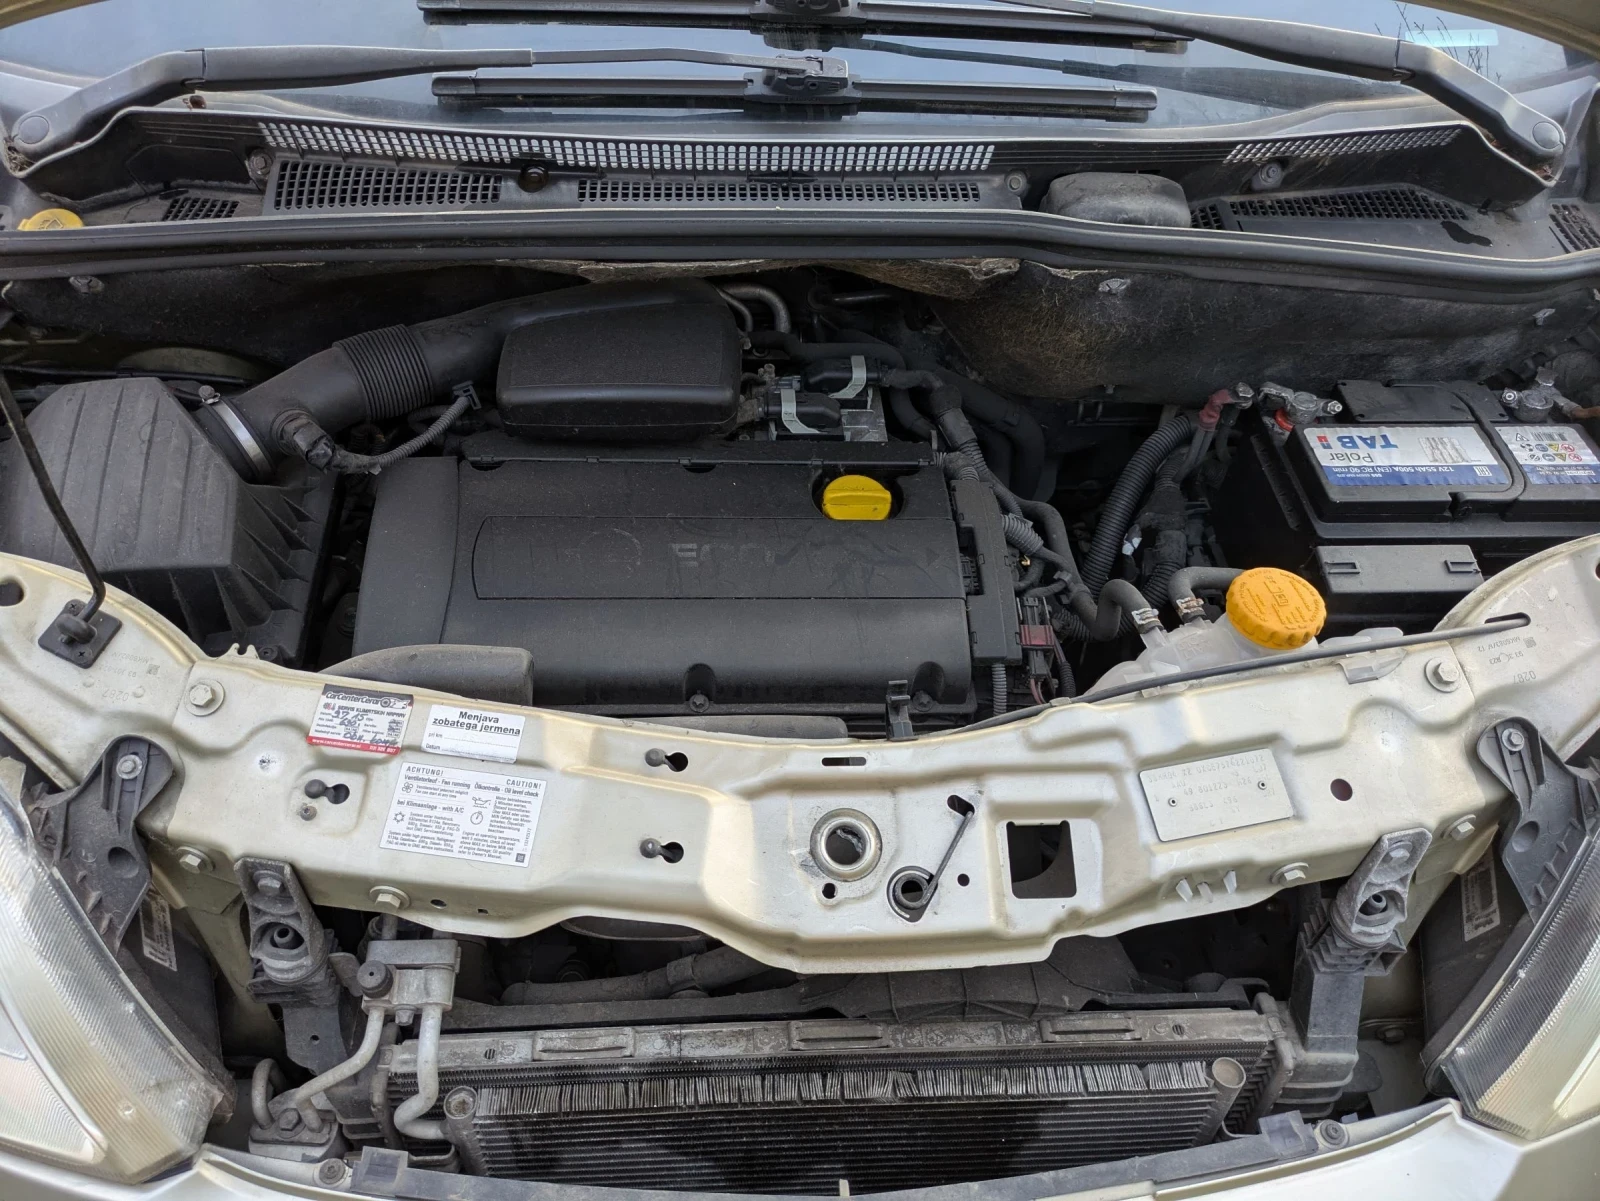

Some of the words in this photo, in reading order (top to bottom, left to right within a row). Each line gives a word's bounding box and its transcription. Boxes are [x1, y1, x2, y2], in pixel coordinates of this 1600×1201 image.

[1337, 433, 1398, 450] TAB
[1329, 452, 1374, 464] Polar
[1513, 670, 1537, 684] 0287
[459, 711, 500, 724] Menjava
[432, 717, 478, 731] zobatega
[479, 722, 521, 736] jermena
[406, 766, 444, 776] ACHTUNG!
[506, 779, 542, 789] CAUTION!
[406, 800, 438, 811] Klimaanlage
